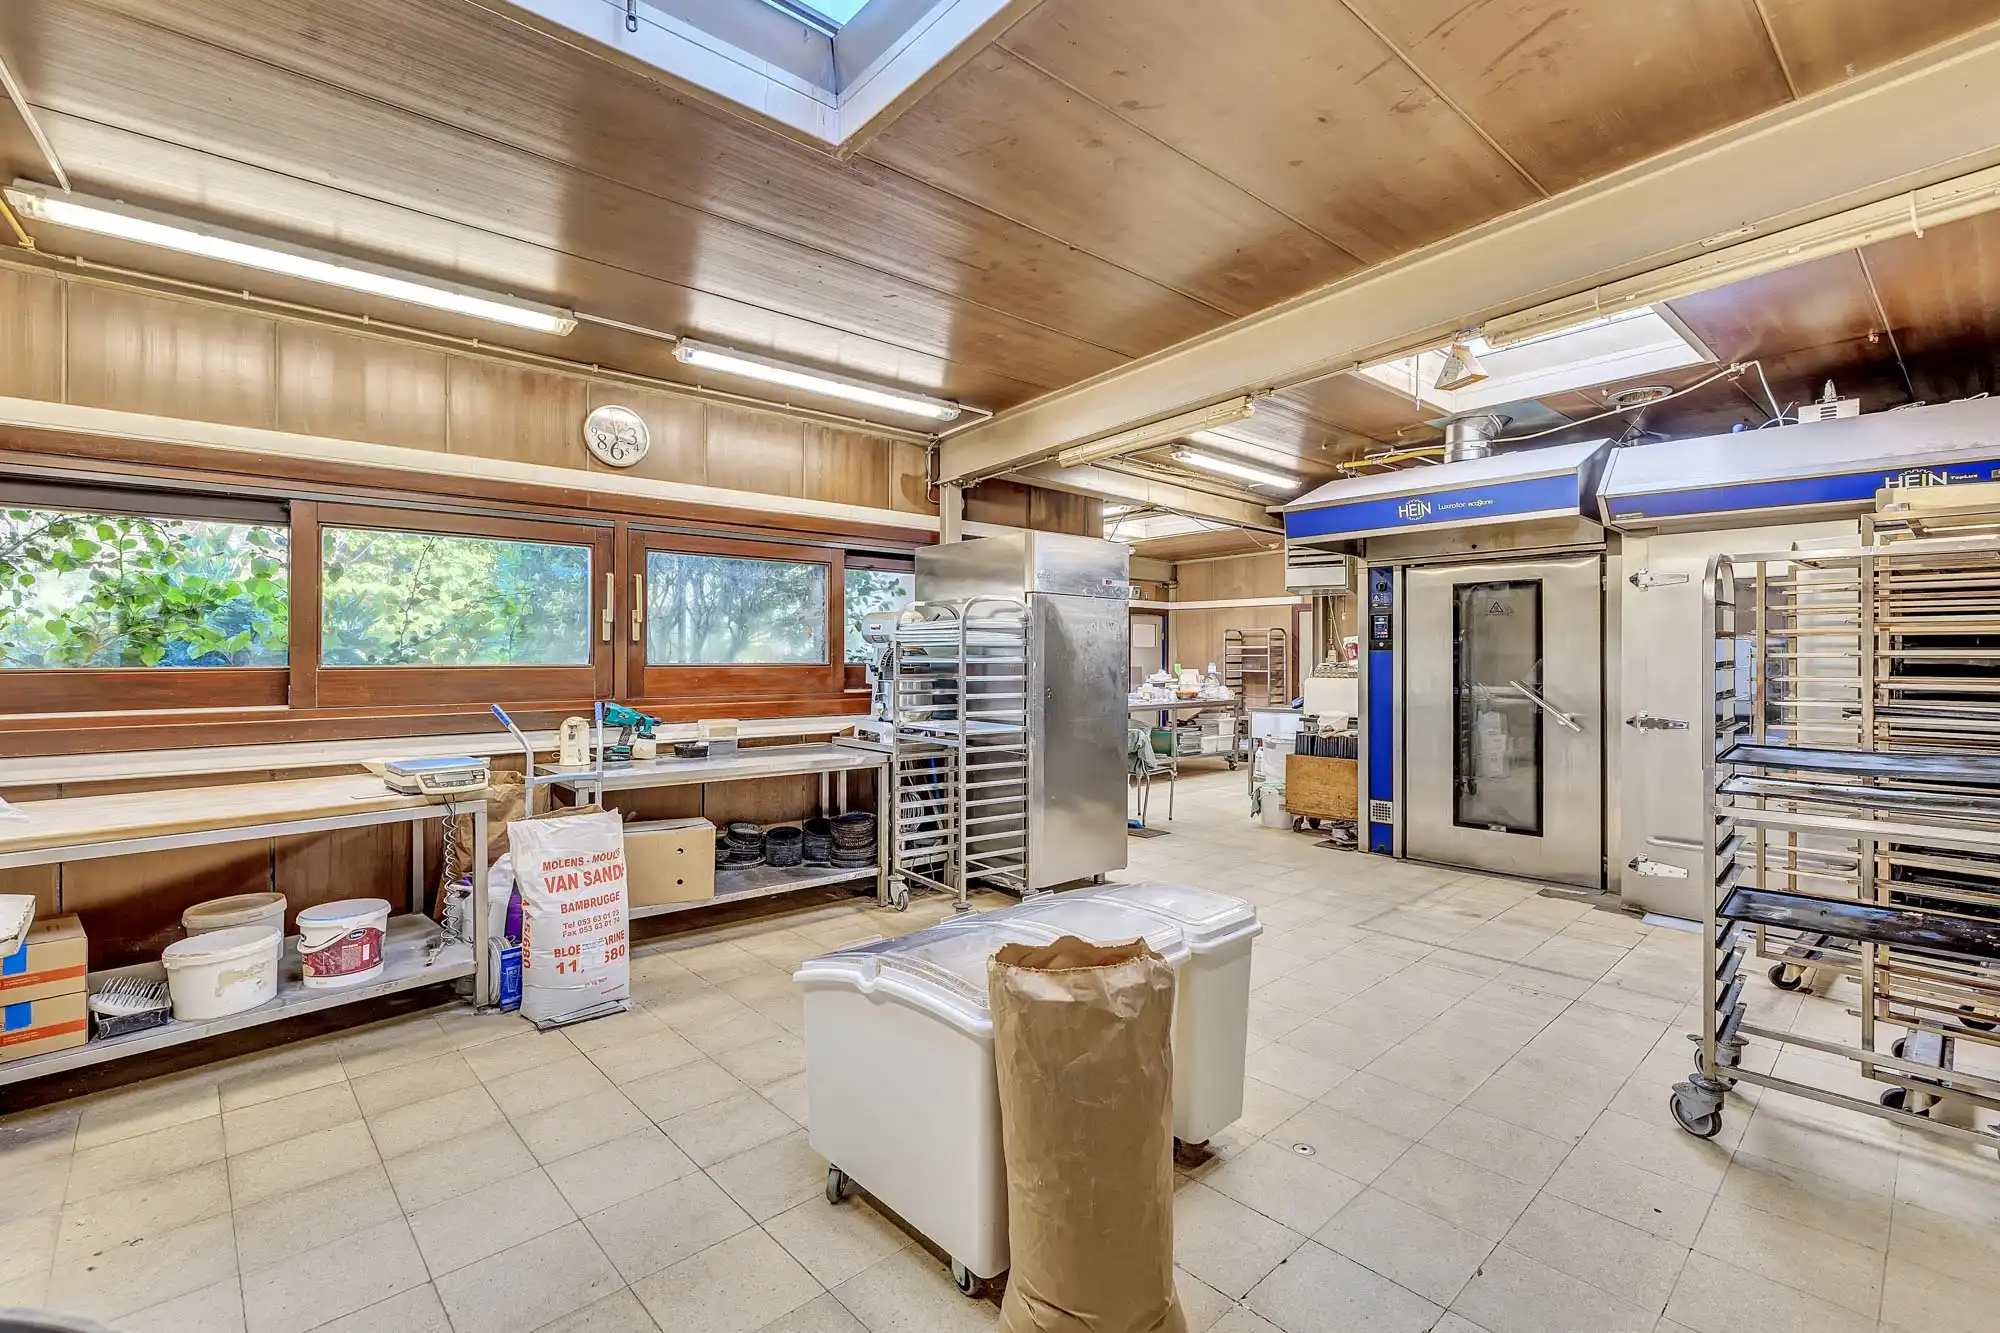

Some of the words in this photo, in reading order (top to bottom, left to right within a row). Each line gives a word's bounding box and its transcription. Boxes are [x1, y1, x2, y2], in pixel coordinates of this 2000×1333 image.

[591, 427, 598, 436] 9
[627, 428, 638, 445] 3
[597, 434, 607, 450] 8
[634, 444, 639, 452] 4
[610, 442, 624, 460] 6
[625, 448, 630, 456] 5
[1885, 471, 1947, 489] HEIN
[1398, 501, 1432, 518] HEIN
[542, 857, 584, 872] MOLENS
[544, 873, 579, 894] VAN
[560, 891, 621, 914] BAMBRUGGE
[562, 929, 577, 938] Fax
[579, 925, 593, 934] 053
[594, 922, 603, 931] 63
[563, 922, 575, 930] Tel
[577, 918, 591, 927] 053
[593, 914, 602, 923] 63
[554, 944, 581, 958] BLOE
